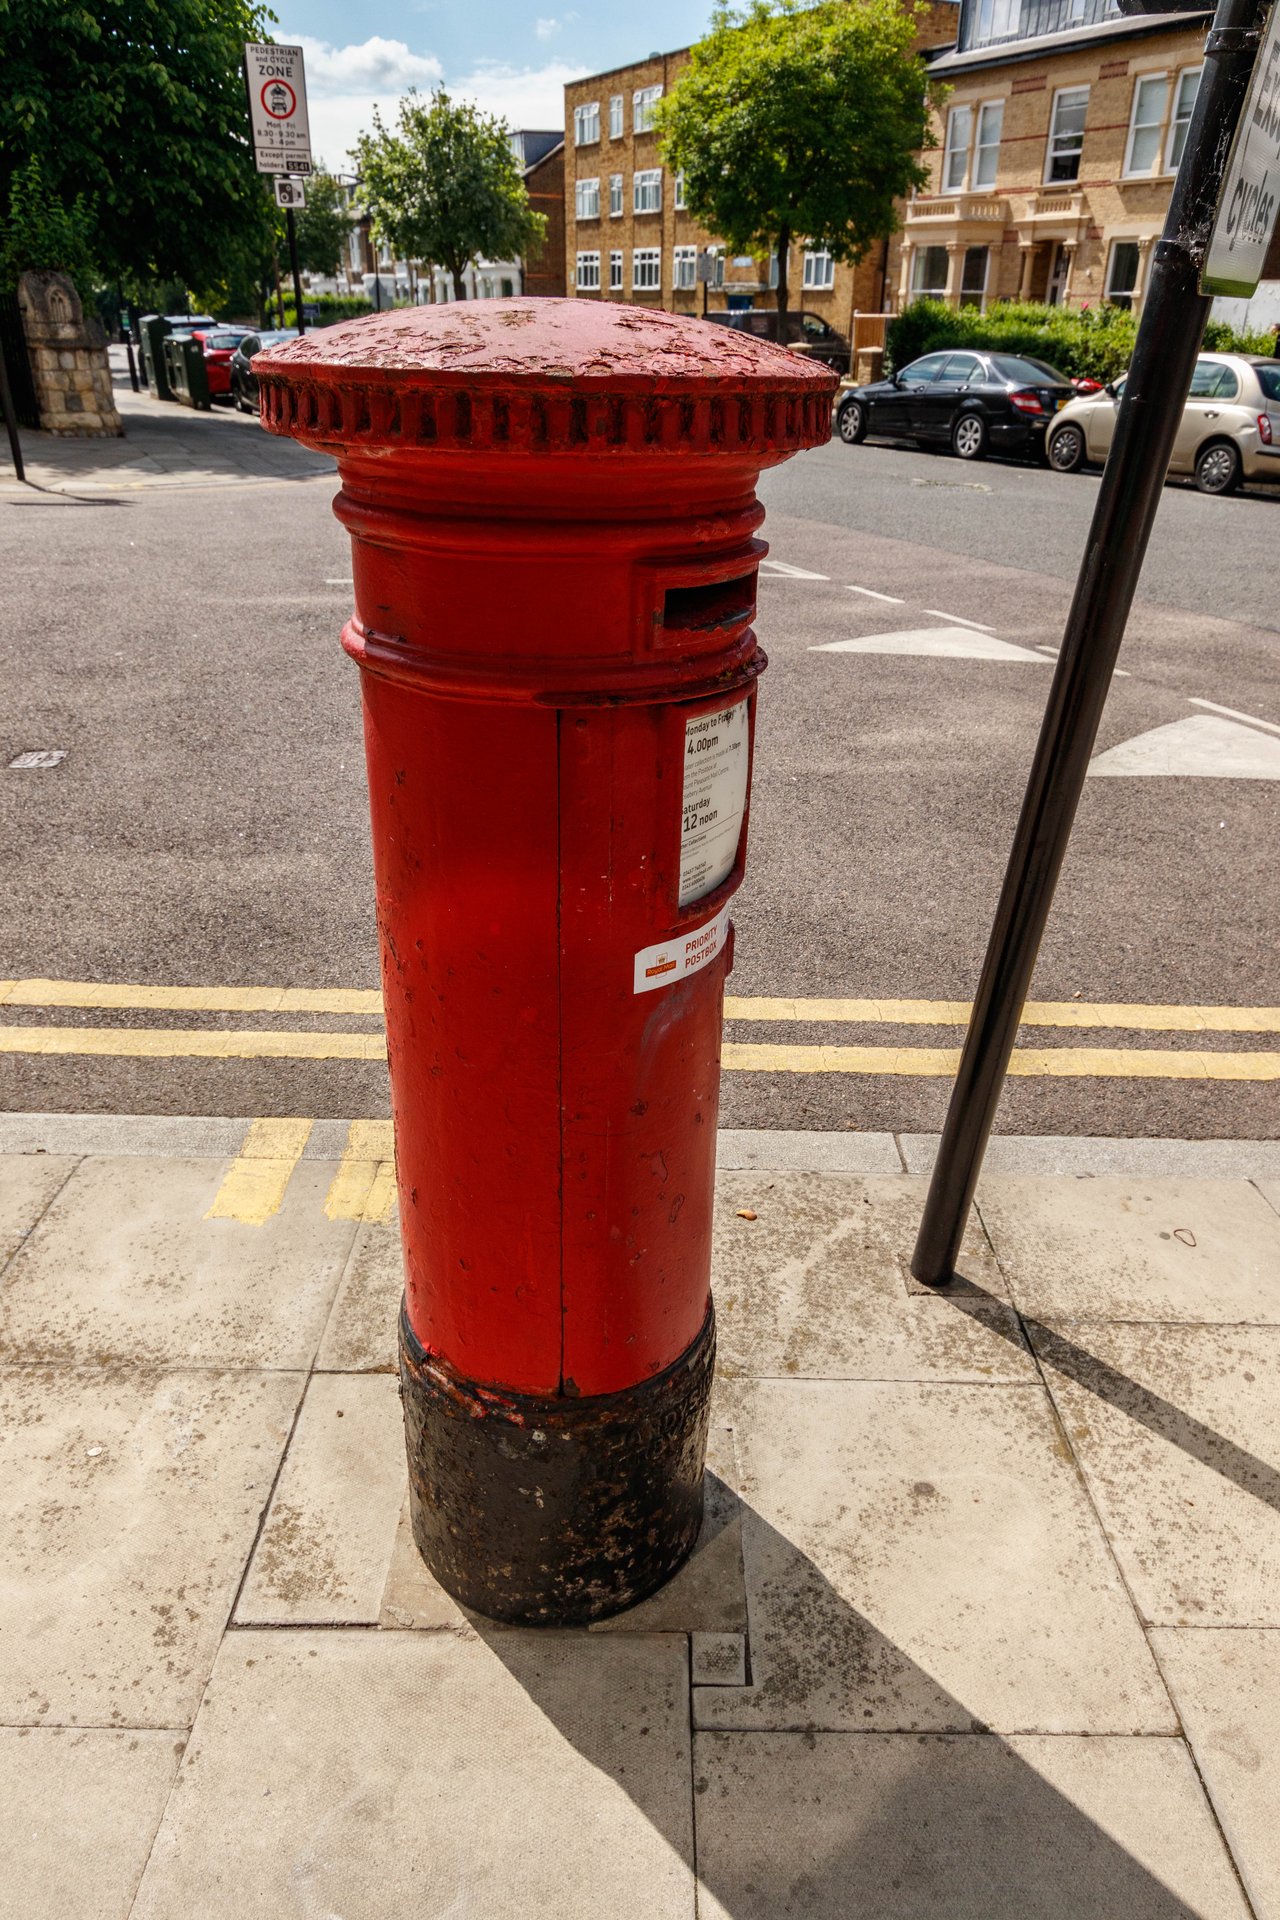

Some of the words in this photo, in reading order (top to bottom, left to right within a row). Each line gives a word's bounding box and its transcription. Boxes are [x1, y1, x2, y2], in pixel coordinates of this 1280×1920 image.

[250, 46, 298, 57] PEDESTRIAN
[270, 56, 294, 65] CYCLE
[259, 65, 293, 78] ZONE
[257, 129, 274, 137] 8.30
[260, 150, 284, 159] Except
[285, 152, 307, 160] permit
[259, 161, 285, 169] holders
[1226, 169, 1274, 252] cycles
[710, 718, 717, 728] to
[687, 736, 718, 755] 4.00pm
[682, 797, 711, 815] aturday
[683, 813, 698, 833] 12
[699, 809, 718, 826] noon
[685, 924, 718, 953] PRIORITY
[685, 940, 717, 968] POSTBOX
[647, 967, 662, 975] Royal
[662, 962, 675, 972] Mail
